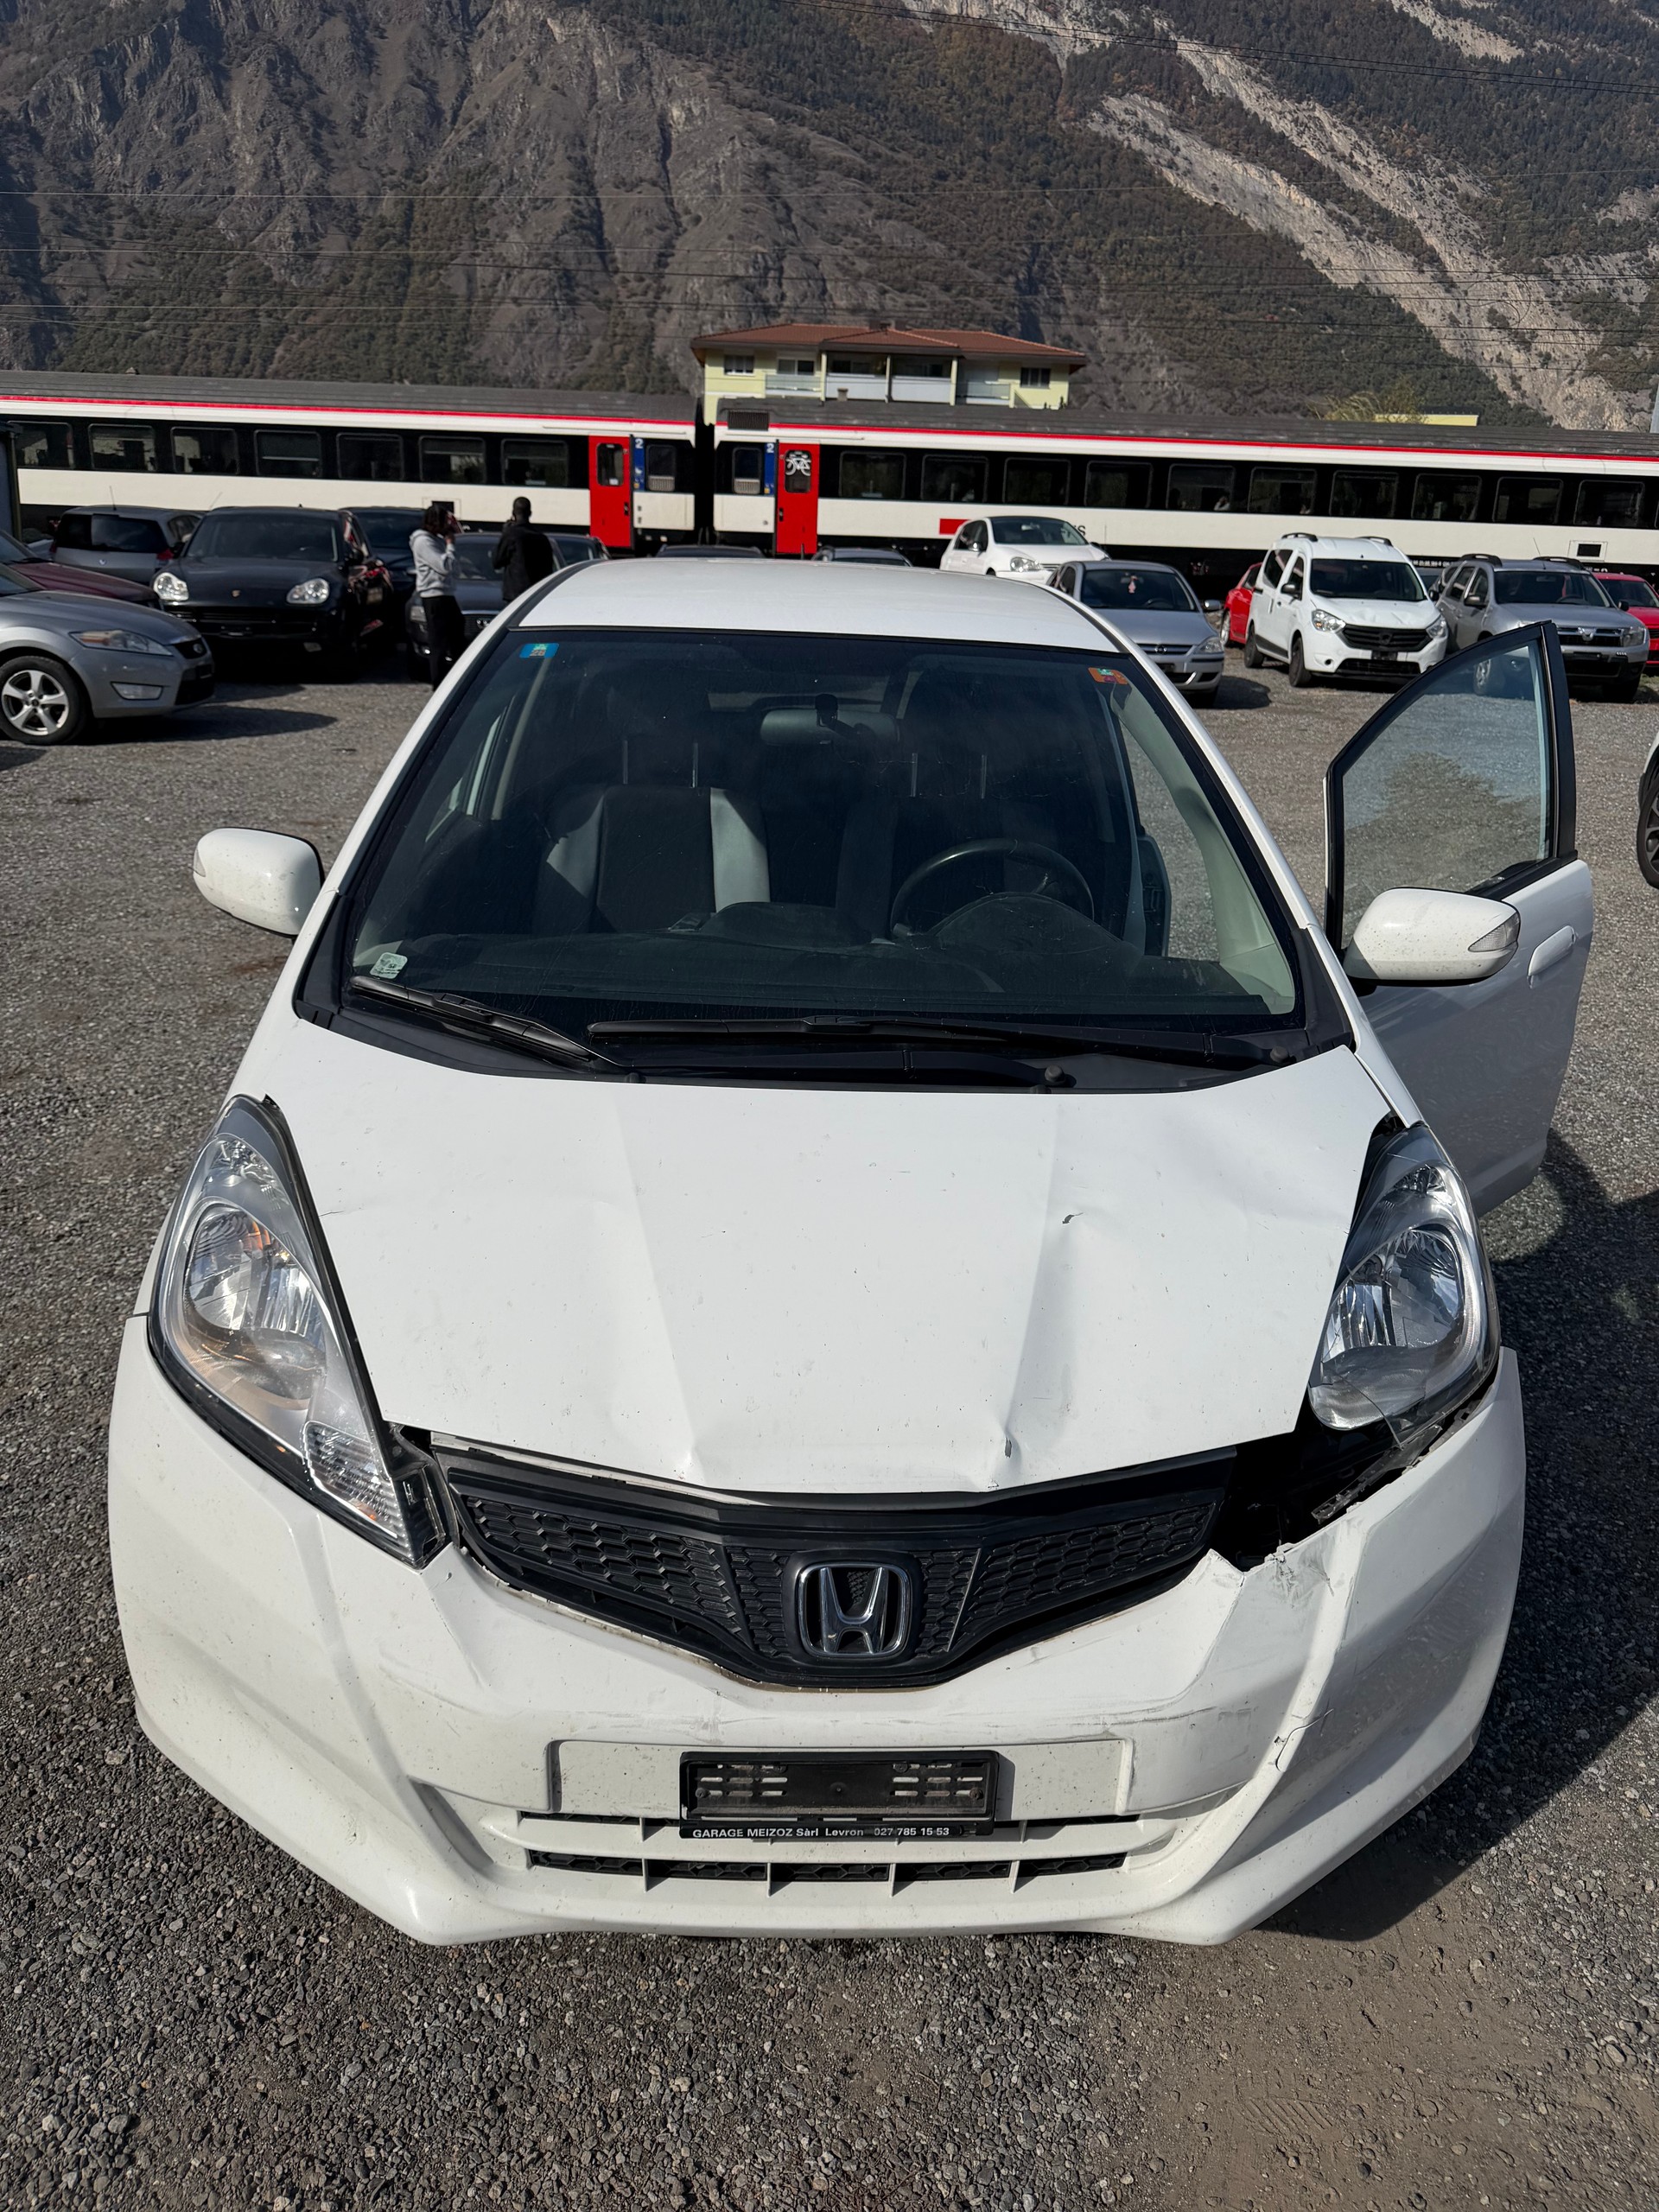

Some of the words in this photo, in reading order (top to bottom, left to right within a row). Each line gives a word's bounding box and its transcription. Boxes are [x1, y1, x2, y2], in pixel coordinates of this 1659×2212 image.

[635, 438, 644, 448] 2
[766, 443, 774, 453] 2
[692, 1828, 744, 1838] GARAGE
[747, 1827, 793, 1837] MEIZOZ
[796, 1827, 819, 1837] Sàrl
[825, 1827, 864, 1836] Levron
[874, 1827, 893, 1836] 027
[897, 1827, 917, 1836] 785
[920, 1827, 933, 1836] 15
[936, 1827, 950, 1836] 53
